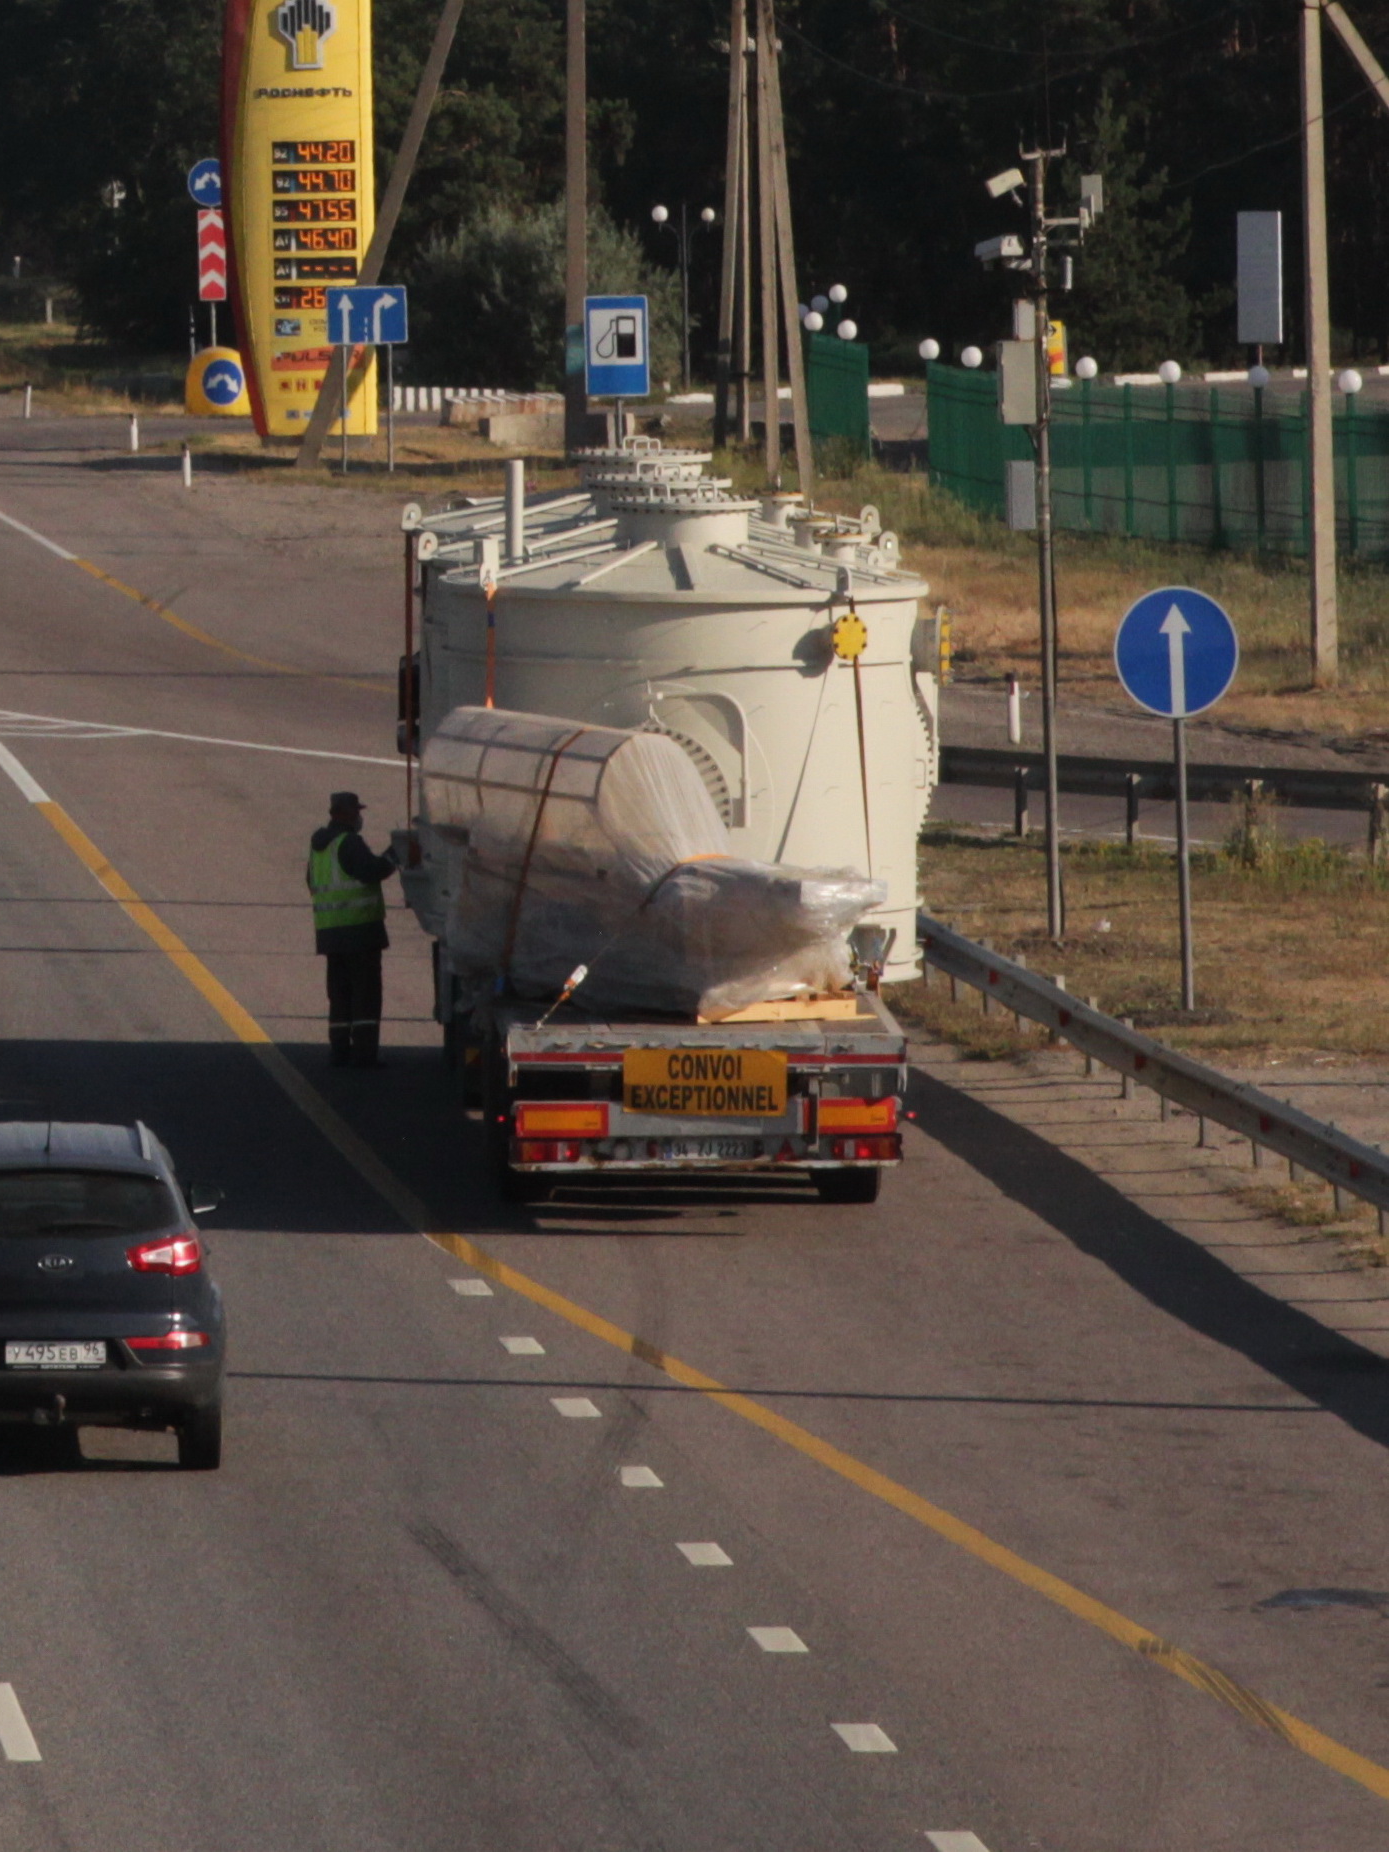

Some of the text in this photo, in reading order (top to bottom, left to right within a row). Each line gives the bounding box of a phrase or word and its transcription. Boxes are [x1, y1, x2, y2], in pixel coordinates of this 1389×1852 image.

[258, 87, 353, 98] РОСНЕФТЬ
[667, 1053, 743, 1081] CONVOI
[630, 1084, 779, 1111] EXCEPTIONNEL
